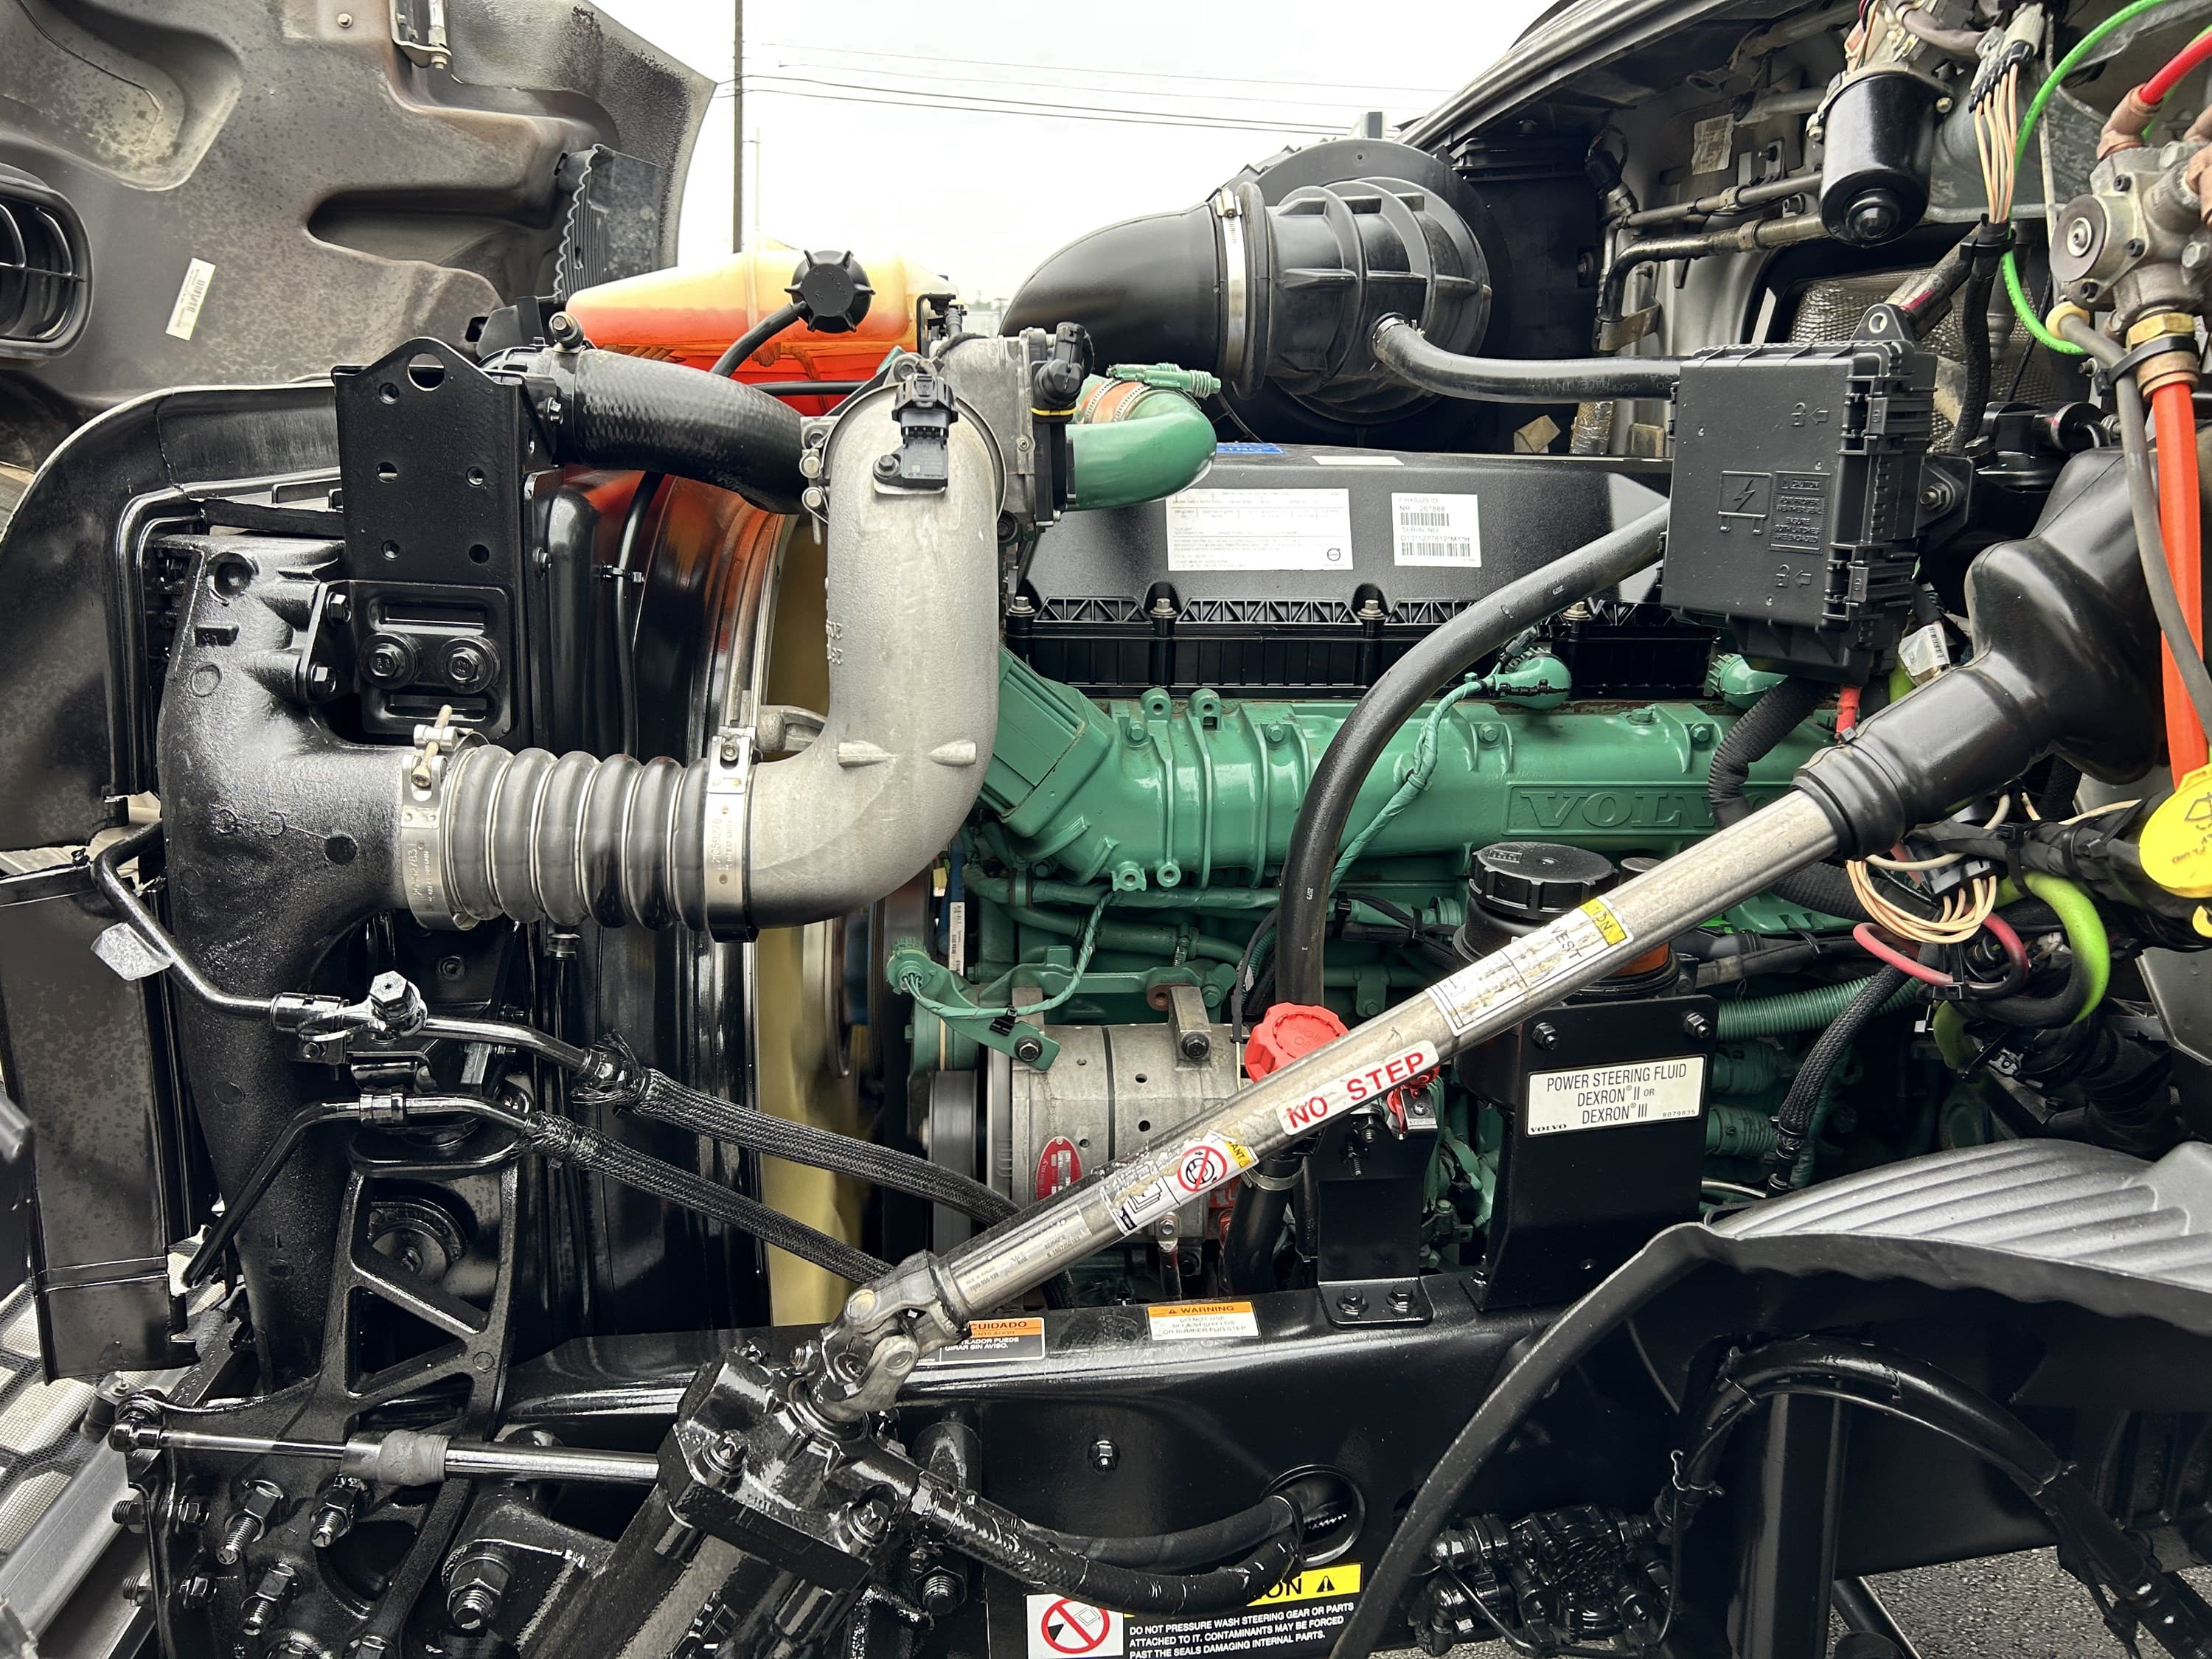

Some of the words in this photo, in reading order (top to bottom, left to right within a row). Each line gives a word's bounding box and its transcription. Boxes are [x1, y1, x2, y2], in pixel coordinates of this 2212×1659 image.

[1286, 1096, 1328, 1129] NO
[1346, 1052, 1423, 1101] STEP
[1547, 1074, 1589, 1092] POWER
[1593, 1067, 1650, 1087] STEERING
[1654, 1063, 1686, 1080] FLUID
[1634, 1086, 1640, 1100] II
[1644, 1088, 1655, 1096] OR
[1531, 1124, 1567, 1133] VOLVO
[1662, 1110, 1696, 1118] 8079835
[1638, 1104, 1647, 1118] III
[970, 1321, 1027, 1329] CUIDADO
[1130, 1627, 1143, 1635] DO
[1145, 1625, 1164, 1635] NOT
[1166, 1621, 1212, 1632] PRESSURE
[1214, 1618, 1240, 1628] WASH
[1242, 1613, 1284, 1625] STEERING
[1286, 1609, 1310, 1618] GEAR
[1312, 1607, 1324, 1615] OR
[1326, 1602, 1354, 1614] PARTS
[1130, 1636, 1177, 1647] ATTACHED
[1178, 1635, 1191, 1644] TO
[1192, 1633, 1203, 1643] IT.
[1205, 1625, 1273, 1641] CONTAMINANTS
[1274, 1623, 1293, 1632] MAY
[1295, 1621, 1307, 1630] BE
[1309, 1616, 1344, 1629] FORCED
[1130, 1650, 1153, 1659] PAST
[1155, 1649, 1172, 1658] THE
[1174, 1646, 1201, 1657] SEALS
[1203, 1641, 1251, 1654] DAMAGING
[1253, 1636, 1293, 1648] INTERNAL
[1295, 1630, 1325, 1643] PARTS.
